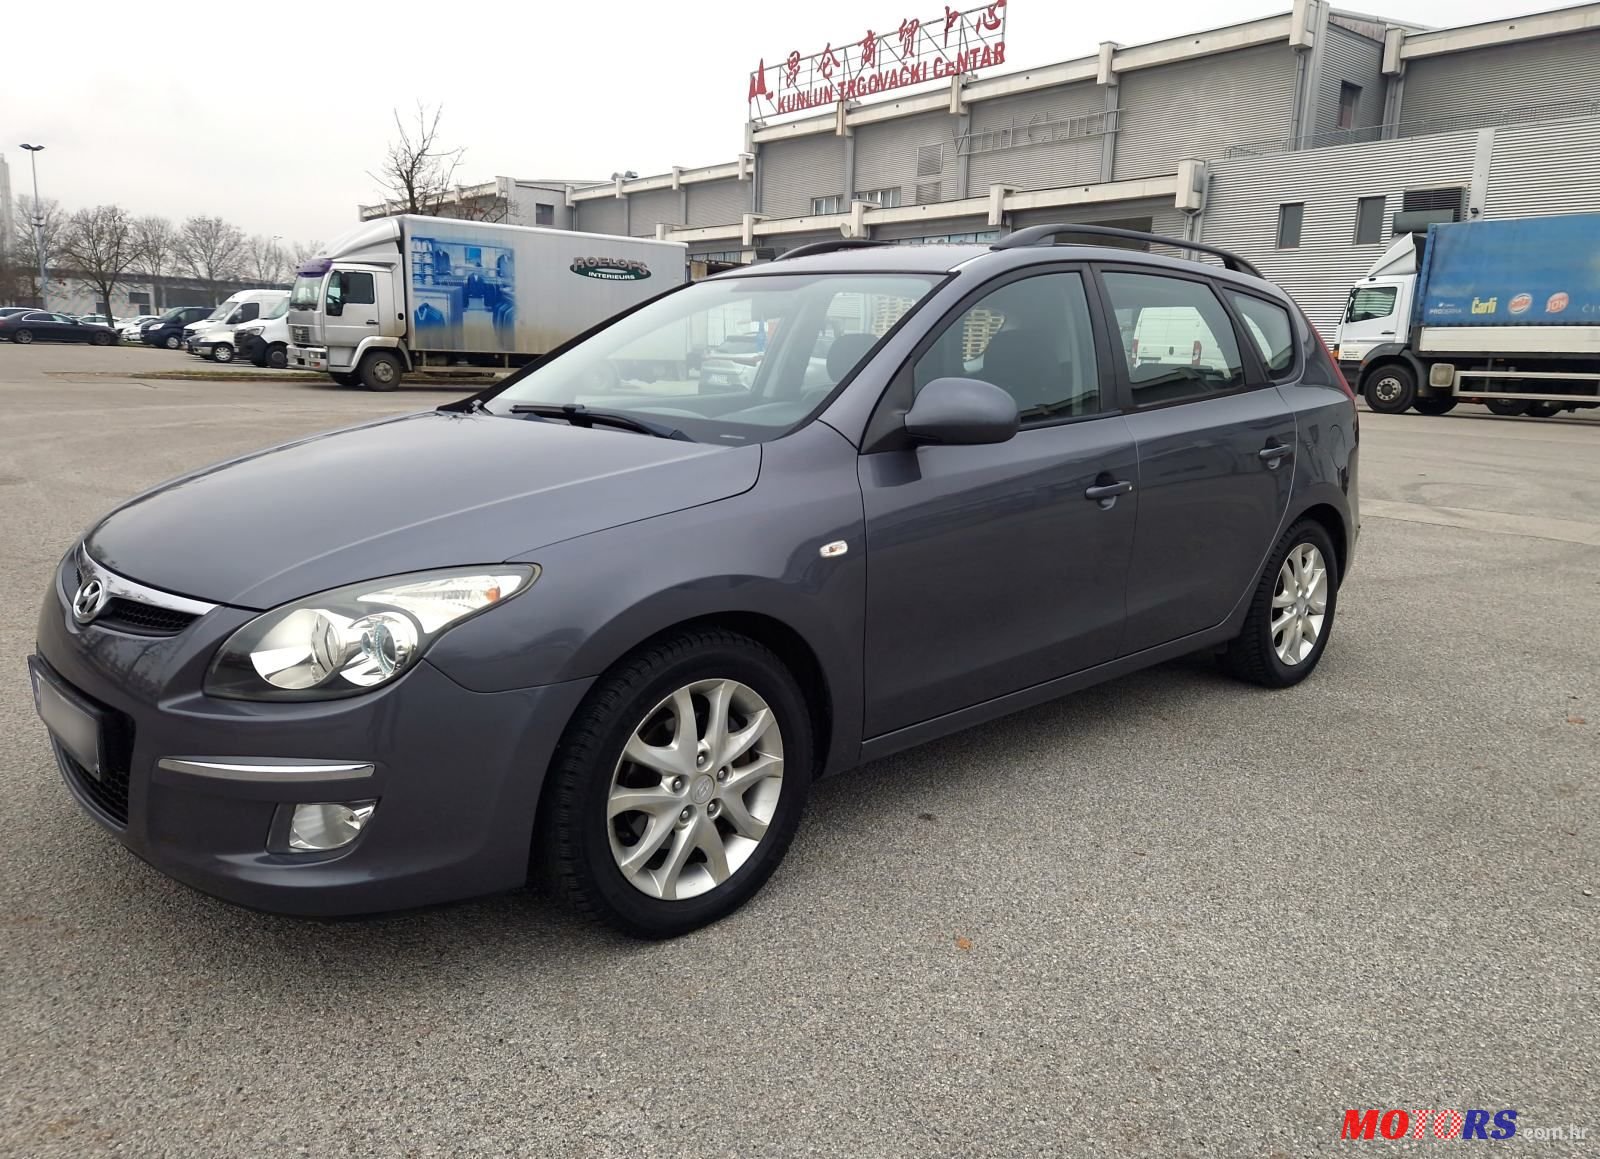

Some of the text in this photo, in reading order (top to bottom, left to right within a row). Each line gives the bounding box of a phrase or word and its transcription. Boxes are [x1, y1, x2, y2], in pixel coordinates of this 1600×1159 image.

[777, 41, 1006, 115] KUNLUN TRGOVAČKI CENTAR
[573, 257, 648, 275] ROELOFS
[588, 271, 635, 280] INTERIEURS
